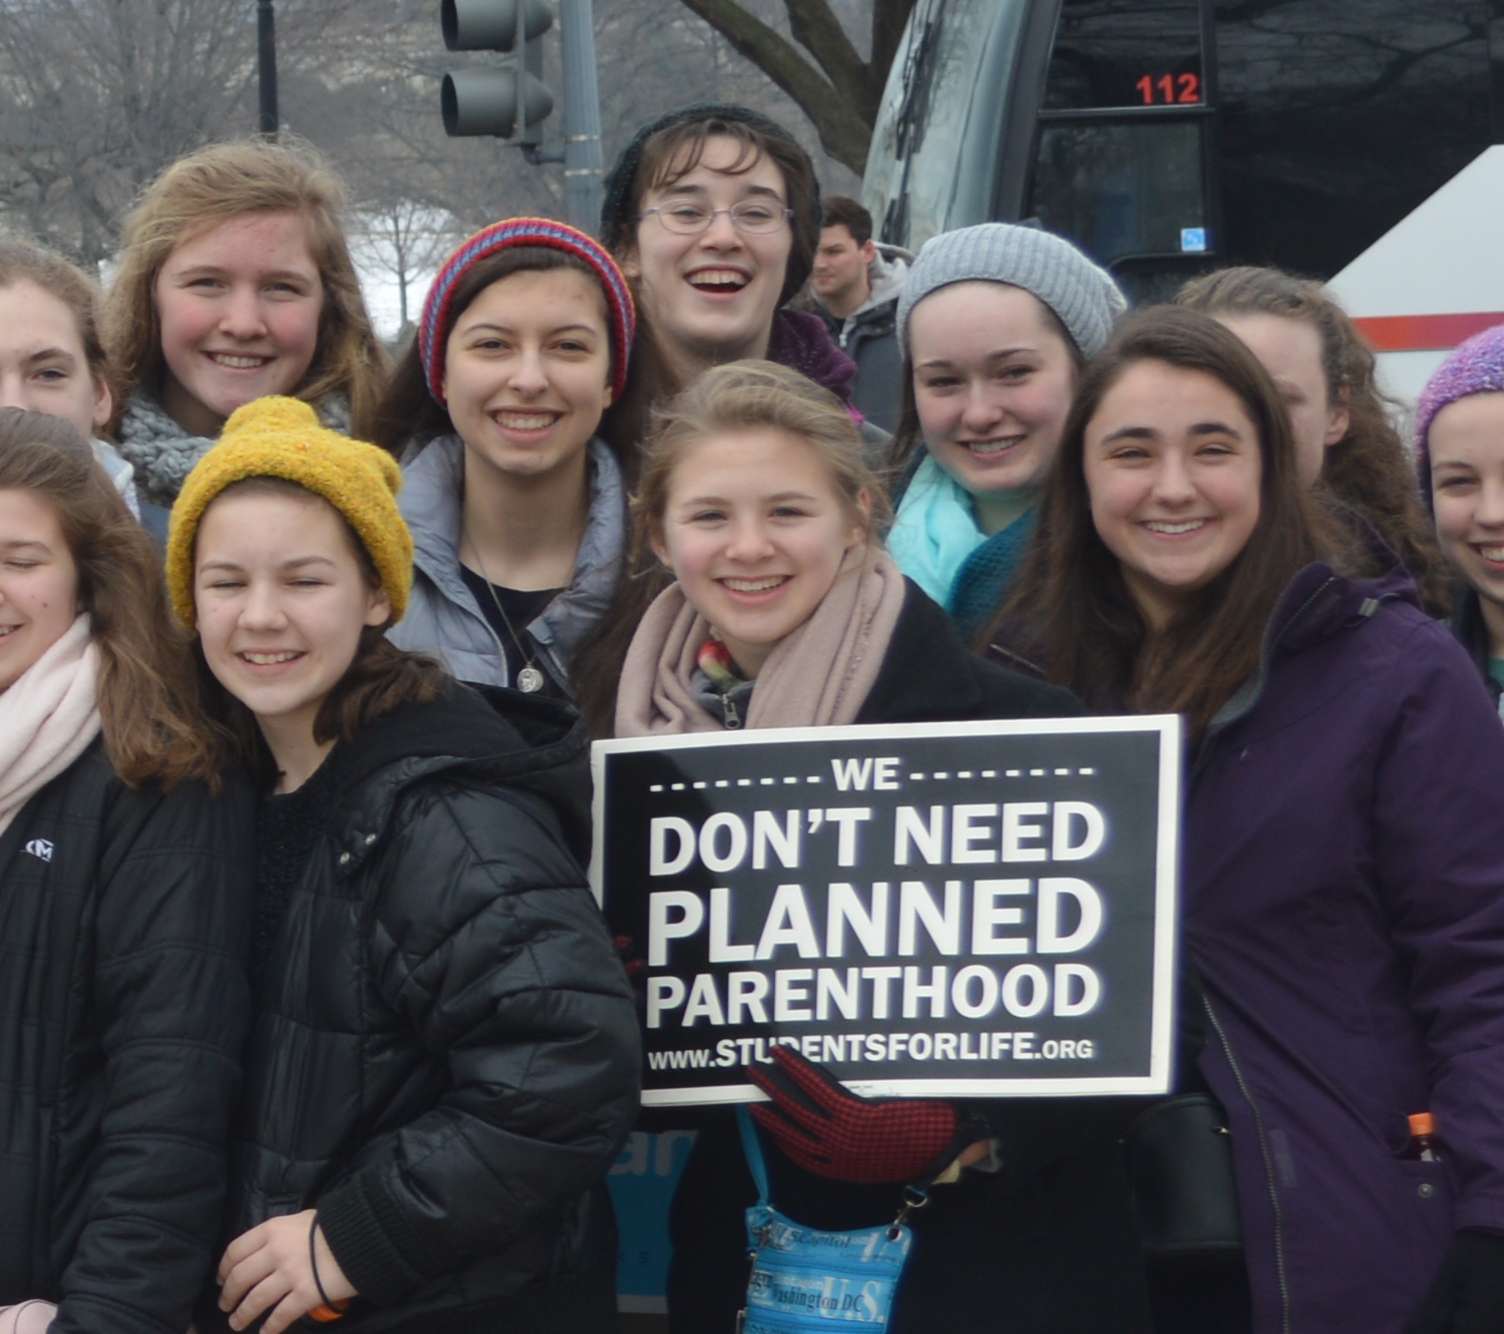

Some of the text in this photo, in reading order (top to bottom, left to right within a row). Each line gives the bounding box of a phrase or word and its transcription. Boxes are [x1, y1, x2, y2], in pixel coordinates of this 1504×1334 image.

[1136, 73, 1199, 105] 112
[831, 757, 901, 792] WE
[894, 801, 1106, 866] NEED
[647, 877, 1104, 967] PLANNED
[646, 963, 1101, 1029] PARENTHOOD
